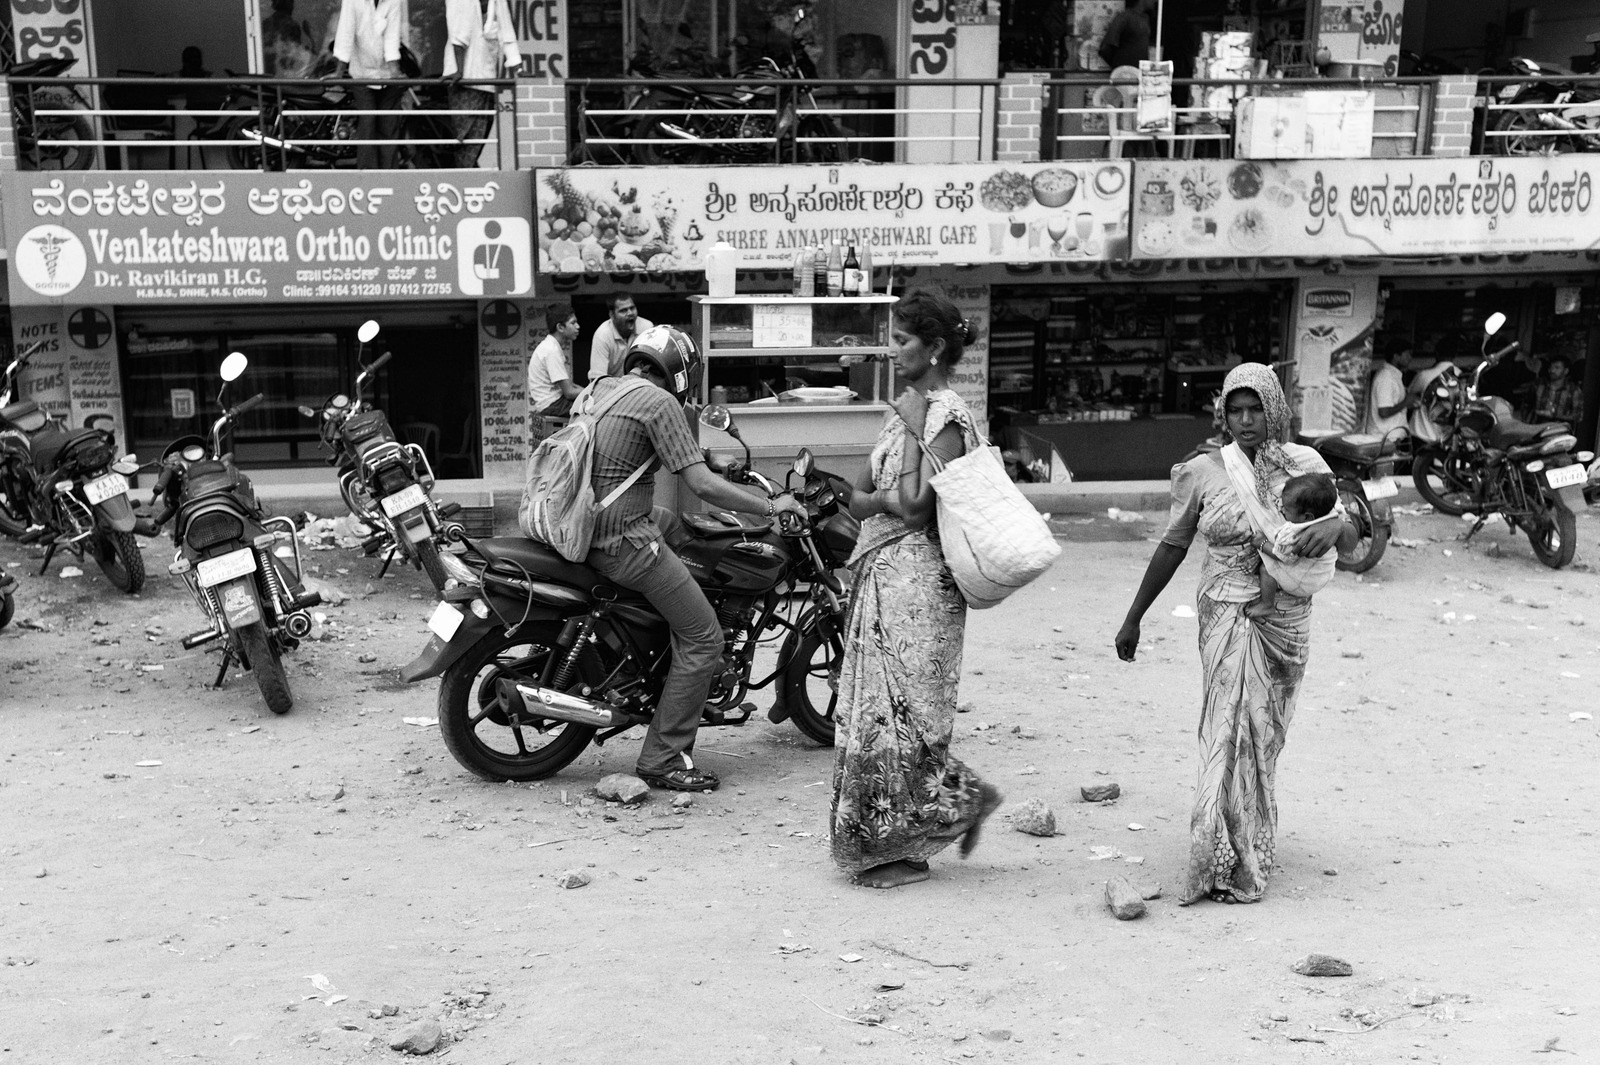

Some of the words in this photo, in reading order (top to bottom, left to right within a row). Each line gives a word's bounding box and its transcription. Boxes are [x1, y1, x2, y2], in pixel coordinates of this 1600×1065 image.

[31, 179, 226, 226] ವೆಂಕಟೇಶ್ವರ
[88, 226, 289, 264] Venkateshwara
[296, 226, 370, 262] Ortho
[378, 226, 452, 261] Clinic
[717, 229, 768, 249] SHREE
[35, 282, 70, 290] DOCTOR
[94, 270, 122, 288] Dr.
[128, 269, 218, 287] Ravikiran
[224, 269, 267, 286] H.G.
[283, 284, 313, 297] Clinic
[351, 284, 381, 296] 31220
[389, 283, 420, 295] 97412
[421, 283, 452, 295] 72755
[1307, 293, 1350, 305] BRITANNIA
[21, 322, 58, 339] NOTE
[16, 339, 60, 355] BOKS
